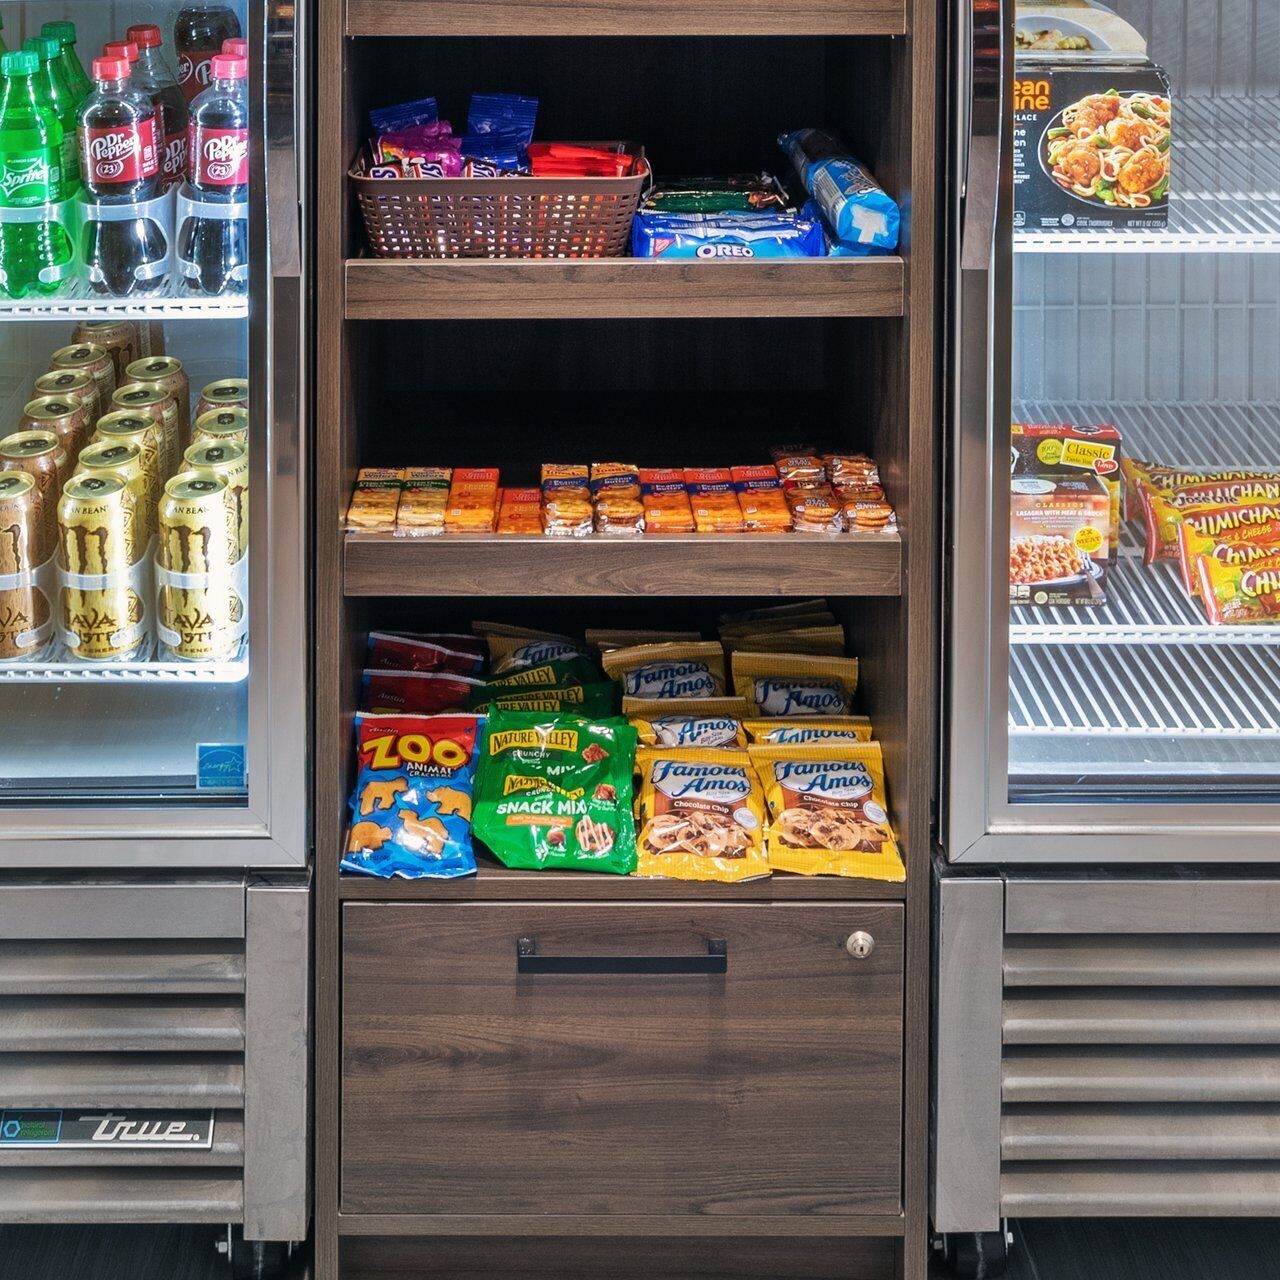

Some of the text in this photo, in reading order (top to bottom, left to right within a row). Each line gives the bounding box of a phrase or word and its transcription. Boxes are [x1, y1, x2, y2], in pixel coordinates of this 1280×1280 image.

[91, 135, 137, 161] Pepper
[106, 133, 126, 146] Dr
[3, 168, 46, 188] Sprite
[102, 164, 115, 174] 23
[213, 165, 226, 175] 23
[696, 243, 754, 258] OREO
[1067, 443, 1111, 460] Classic
[1097, 462, 1114, 470] Love
[1076, 536, 1101, 545] MEAT
[1242, 524, 1273, 540] CHEESE
[515, 666, 555, 686] VALLEY
[626, 662, 709, 694] Famous
[537, 687, 582, 702] VALLEY
[658, 678, 716, 699] Amos
[754, 678, 841, 705] Famous
[515, 700, 559, 712] VALLEY
[777, 690, 844, 716] Amos
[678, 720, 741, 744] Amos
[363, 733, 469, 770] ZOO
[493, 732, 534, 754] NATURE
[512, 750, 551, 758] CRUNCHY
[407, 762, 457, 775] ANIMAL
[651, 760, 747, 785] Famous
[774, 760, 868, 782] Famous
[671, 777, 753, 799] Amos
[799, 771, 875, 792] Amos
[497, 799, 588, 815] SNACK MIX
[674, 800, 730, 813] Chocolate Chip
[803, 795, 839, 808] Chocolate
[79, 1112, 194, 1141] true
